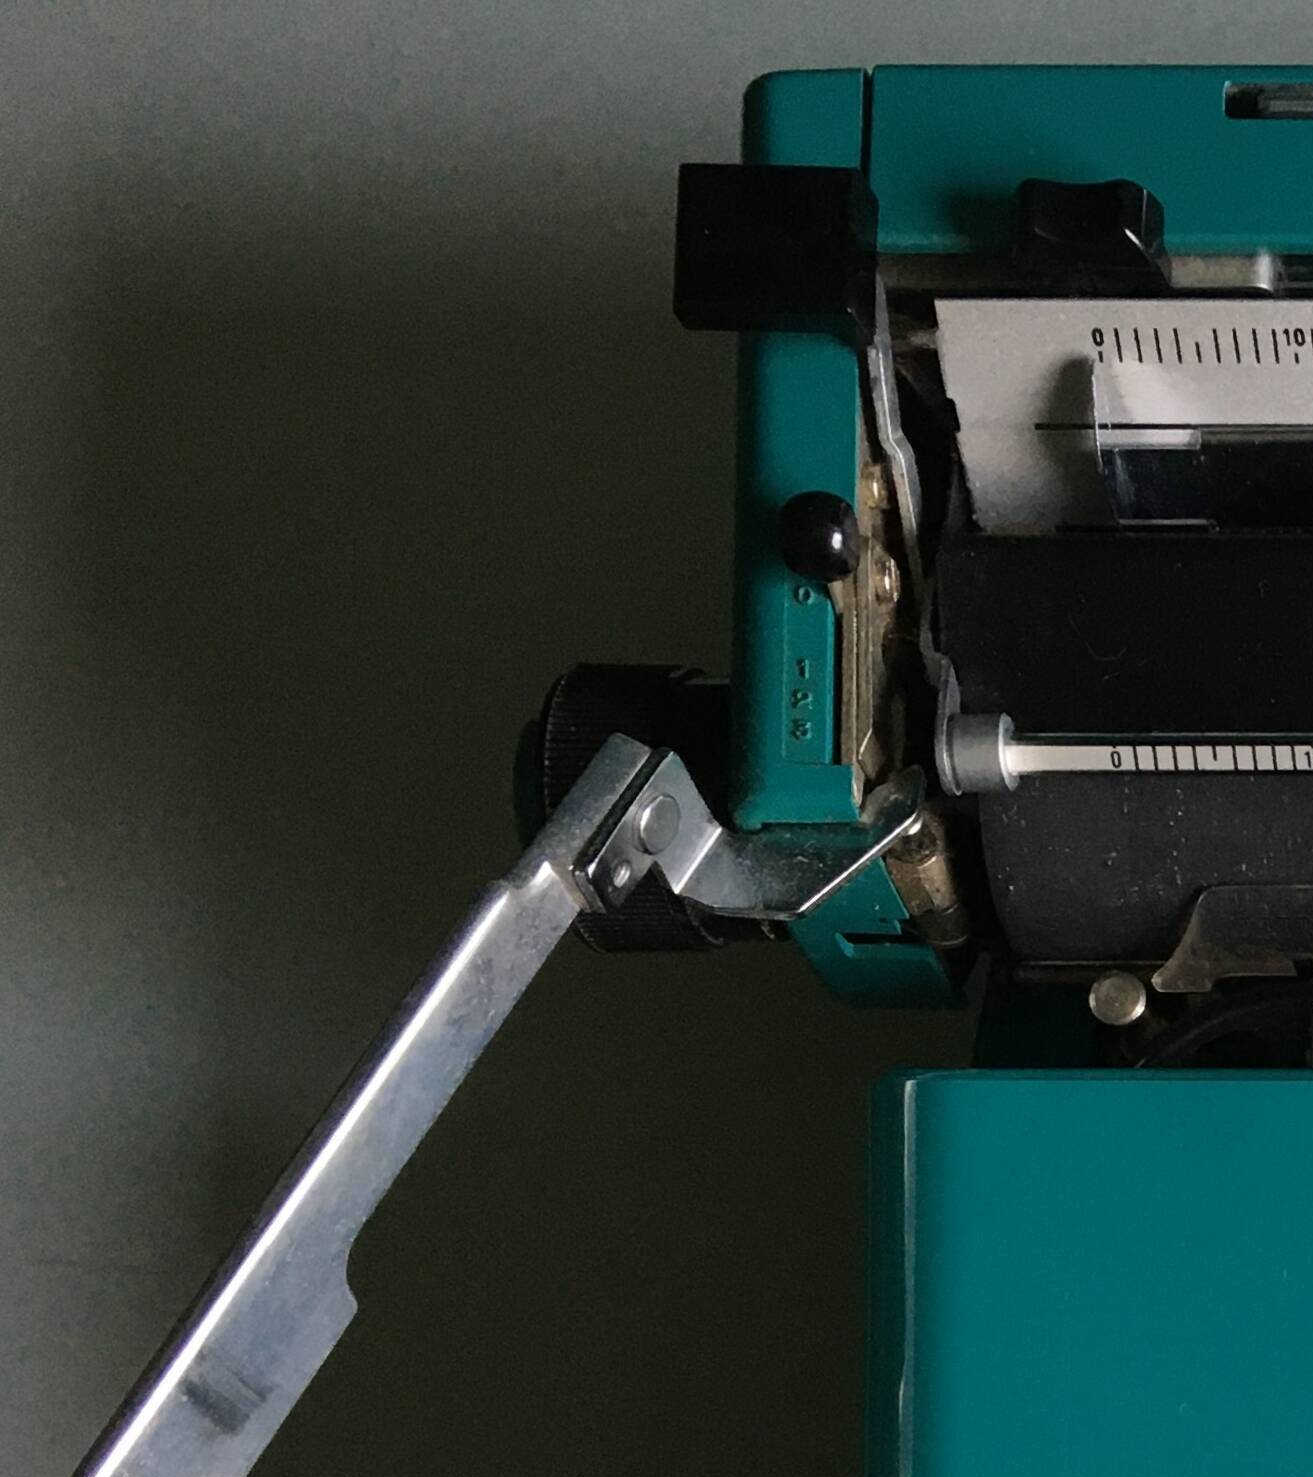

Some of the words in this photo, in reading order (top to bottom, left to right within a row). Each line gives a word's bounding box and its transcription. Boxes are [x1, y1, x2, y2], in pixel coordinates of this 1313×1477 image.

[1091, 329, 1104, 347] 0
[1283, 329, 1306, 346] 10
[1111, 751, 1122, 768] 0
